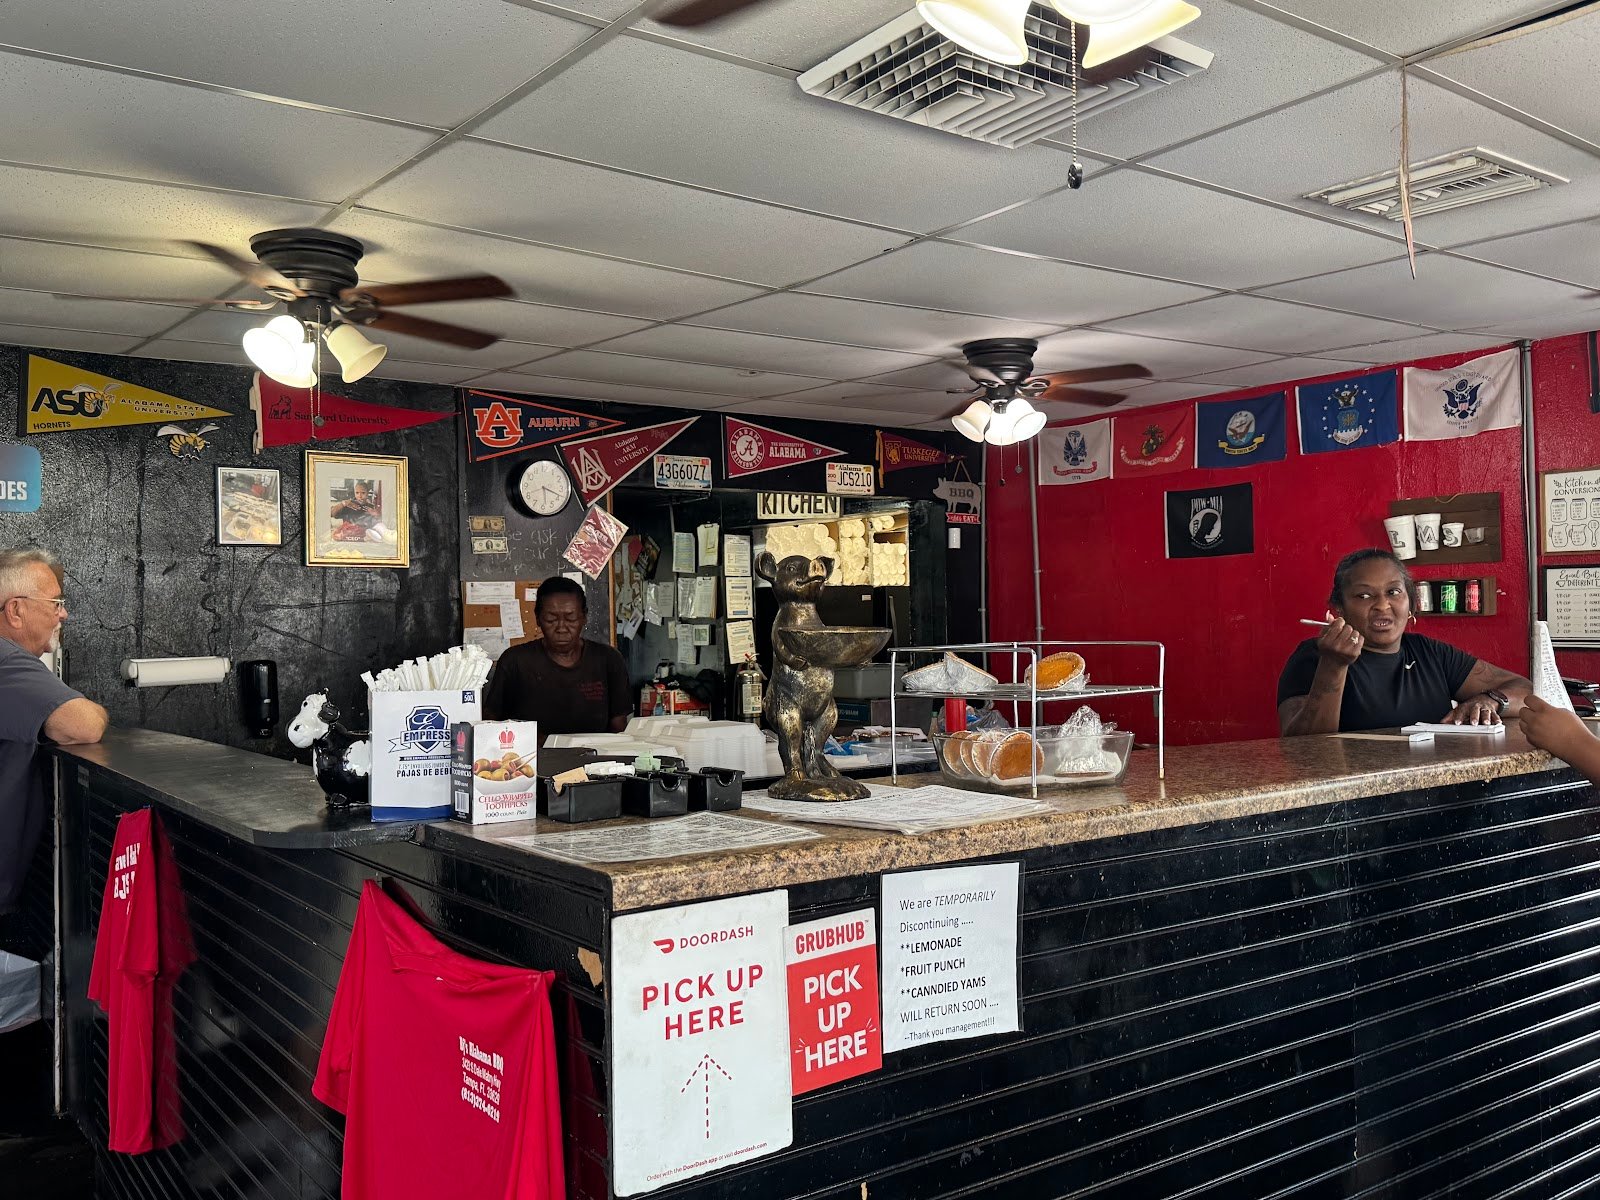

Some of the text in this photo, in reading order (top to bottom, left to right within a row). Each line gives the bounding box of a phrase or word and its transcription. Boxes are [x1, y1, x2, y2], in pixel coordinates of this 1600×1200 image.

[31, 386, 103, 417] ASU
[120, 398, 207, 412] ALABAMA STATE
[134, 406, 196, 417] UNIVERSITY
[33, 421, 71, 430] HORNETS
[528, 417, 580, 428] AUBURN
[614, 445, 649, 466] UNIVERSITY
[769, 446, 807, 459] ALABAMA
[658, 462, 706, 481] 43G60Z7
[837, 471, 872, 488] JCS210
[949, 487, 974, 498] BBQ
[762, 492, 837, 515] KITCHEN
[1388, 530, 1406, 548] L
[1416, 524, 1438, 544] M
[1442, 527, 1459, 546] S
[1559, 569, 1600, 581] Equal But
[404, 730, 451, 742] EMPRESS
[396, 768, 421, 778] PAJAS
[423, 768, 433, 776] DE
[486, 800, 528, 810] TOOTHPICKS
[899, 889, 997, 911] We are TEMPORARILY
[900, 916, 959, 933] Discontinuing
[680, 925, 754, 949] DOORDASH
[795, 921, 866, 955] GRUBHUB
[934, 957, 966, 973] PUNCH
[642, 964, 764, 1011] PICK UP
[804, 964, 863, 1004] PICK
[960, 976, 986, 990] YAMS
[818, 1001, 852, 1033] UP
[900, 1009, 923, 1023] WILL
[924, 1002, 960, 1019] RETURN
[962, 997, 987, 1012] SOON
[665, 1000, 744, 1041] HERE
[931, 1027, 944, 1039] you
[804, 1029, 868, 1073] HERE
[646, 1173, 662, 1181] Order
[662, 1169, 672, 1177] with
[683, 1159, 707, 1171] DoorDash
[708, 1157, 717, 1165] app
[733, 1142, 767, 1156] doordash.com
